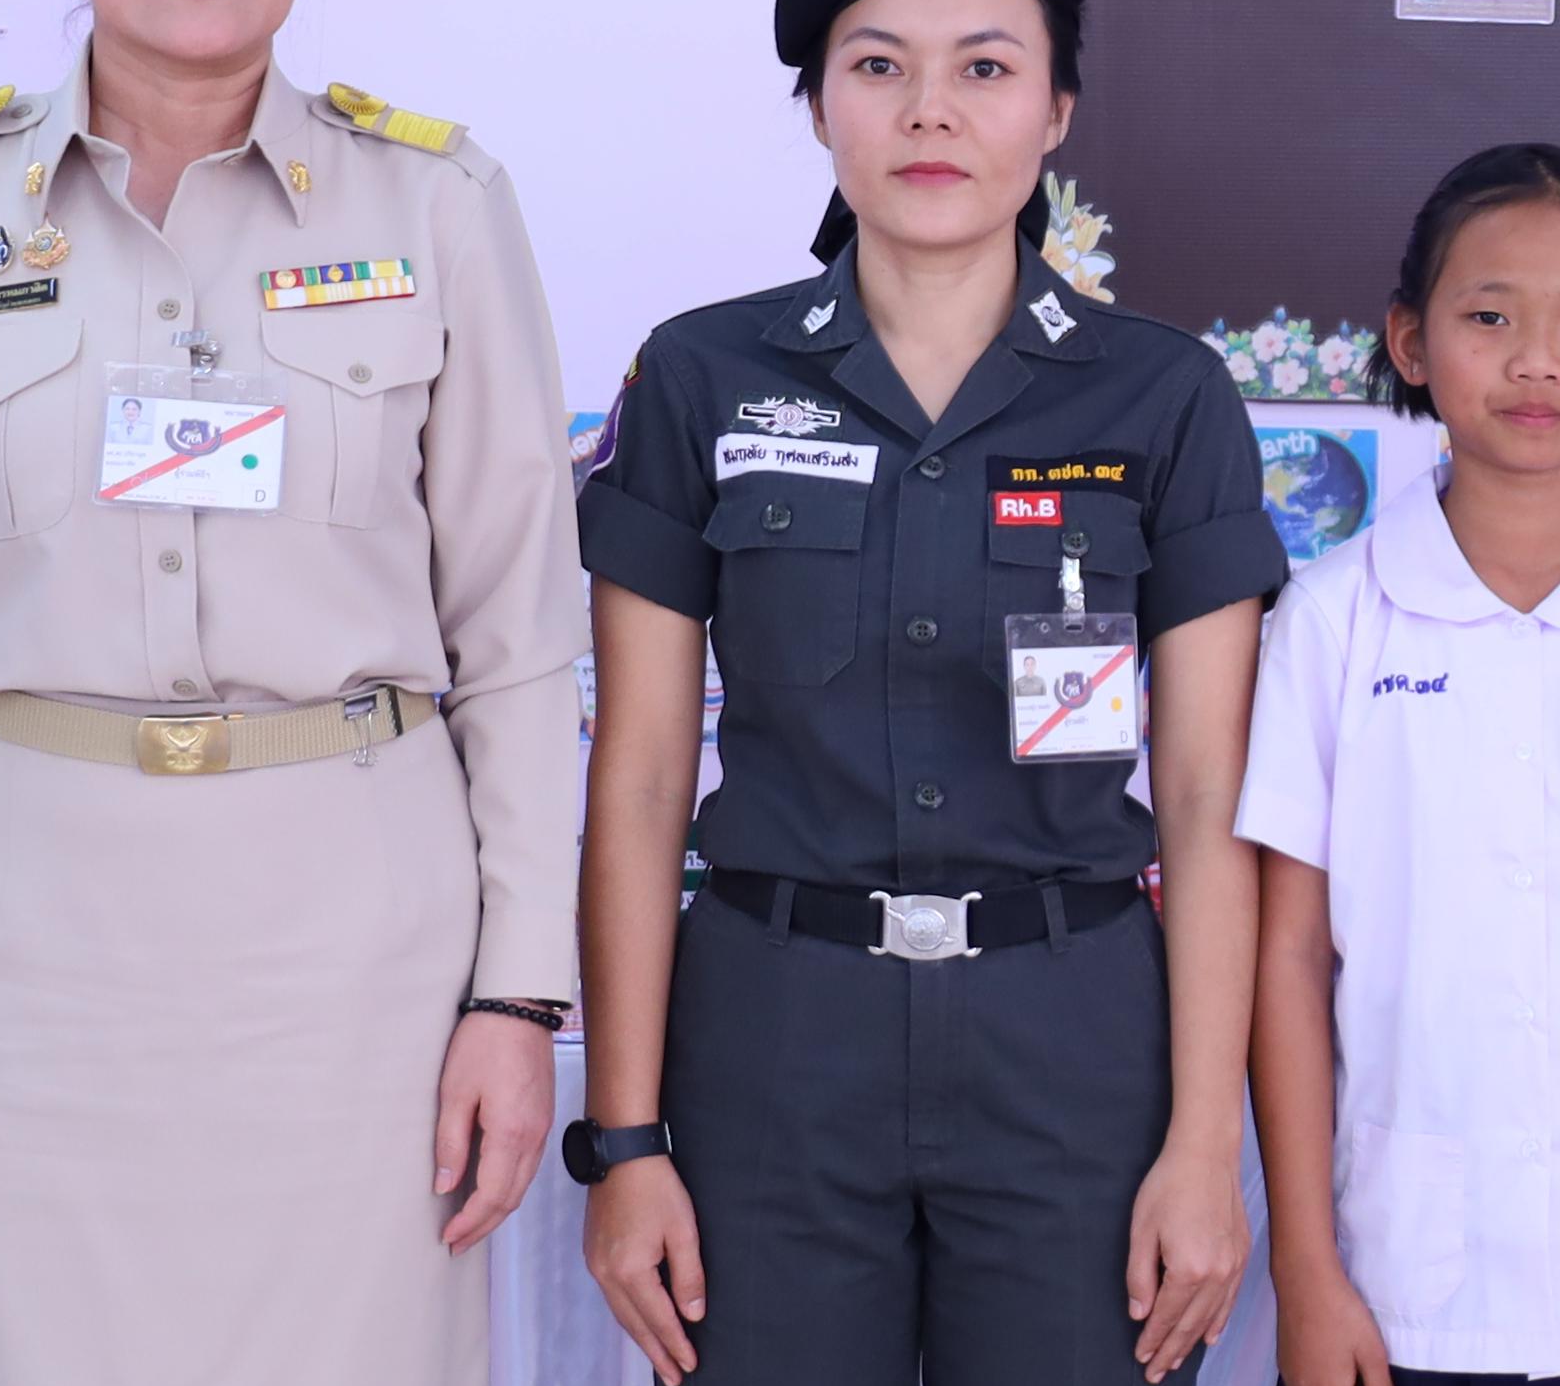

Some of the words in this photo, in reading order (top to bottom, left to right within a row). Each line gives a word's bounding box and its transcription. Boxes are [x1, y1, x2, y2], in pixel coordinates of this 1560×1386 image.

[1260, 431, 1317, 459] arth
[255, 489, 267, 503] D
[1001, 498, 1056, 517] Rh.B
